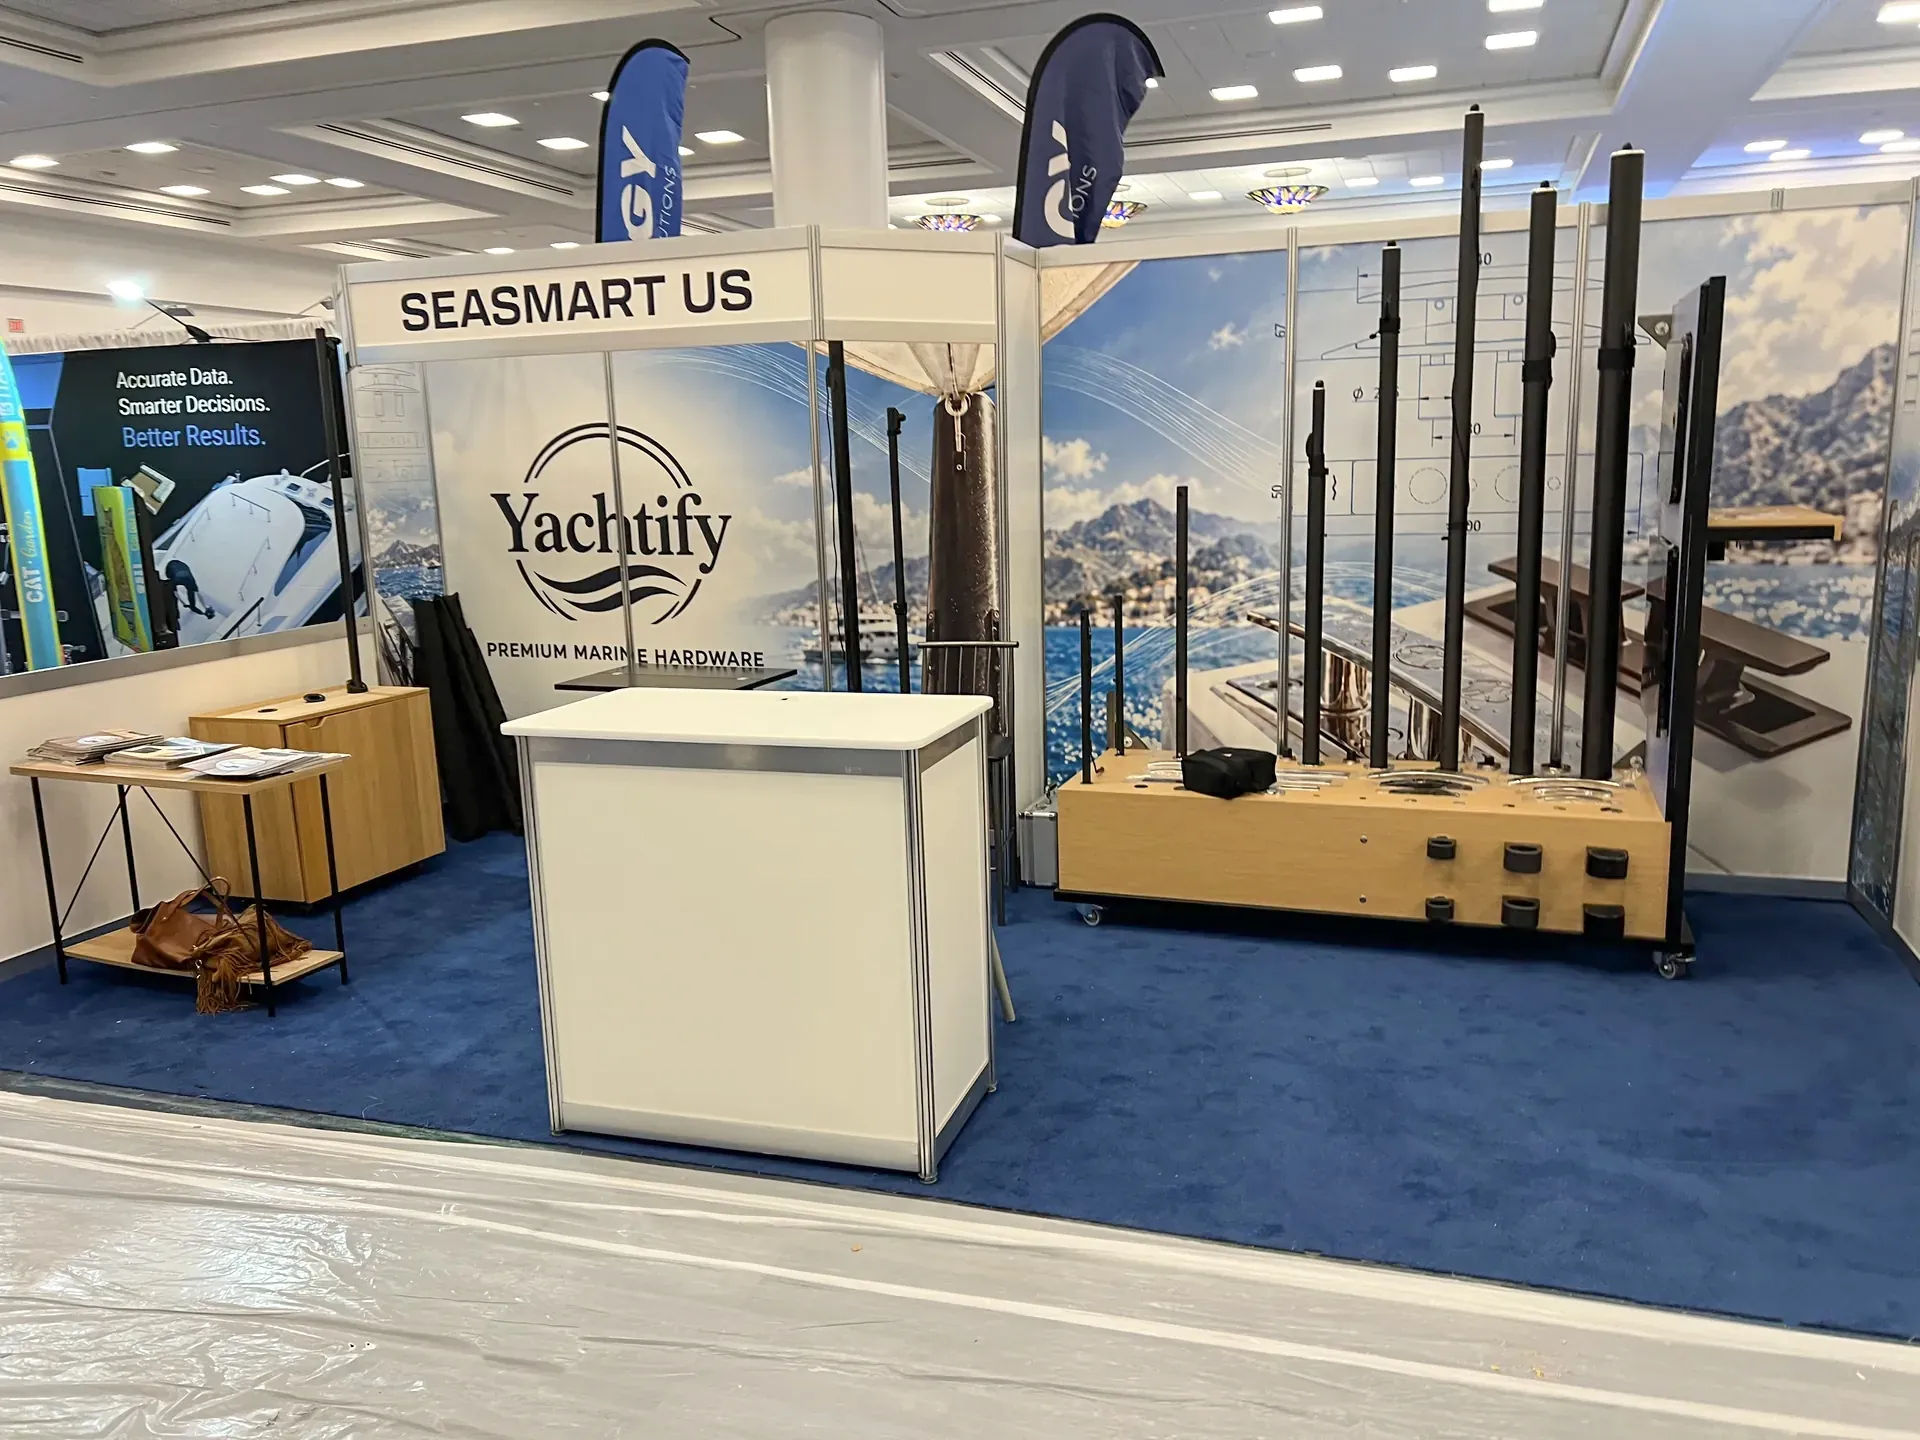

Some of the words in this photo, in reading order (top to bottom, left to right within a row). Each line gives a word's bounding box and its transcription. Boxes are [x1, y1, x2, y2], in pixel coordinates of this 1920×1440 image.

[401, 275, 666, 331] SEASMART
[682, 269, 753, 314] US
[116, 371, 187, 389] Accurate
[190, 368, 234, 386] Data.
[118, 398, 183, 416] Smarter
[185, 394, 271, 413] Decisions.
[122, 427, 181, 448] Better
[186, 423, 266, 446] Results.
[489, 491, 732, 575] Yachtify
[22, 566, 44, 603] CAT
[487, 642, 567, 659] PREMIUM
[574, 645, 648, 664] MARINE
[655, 649, 765, 667] HARDWARE
